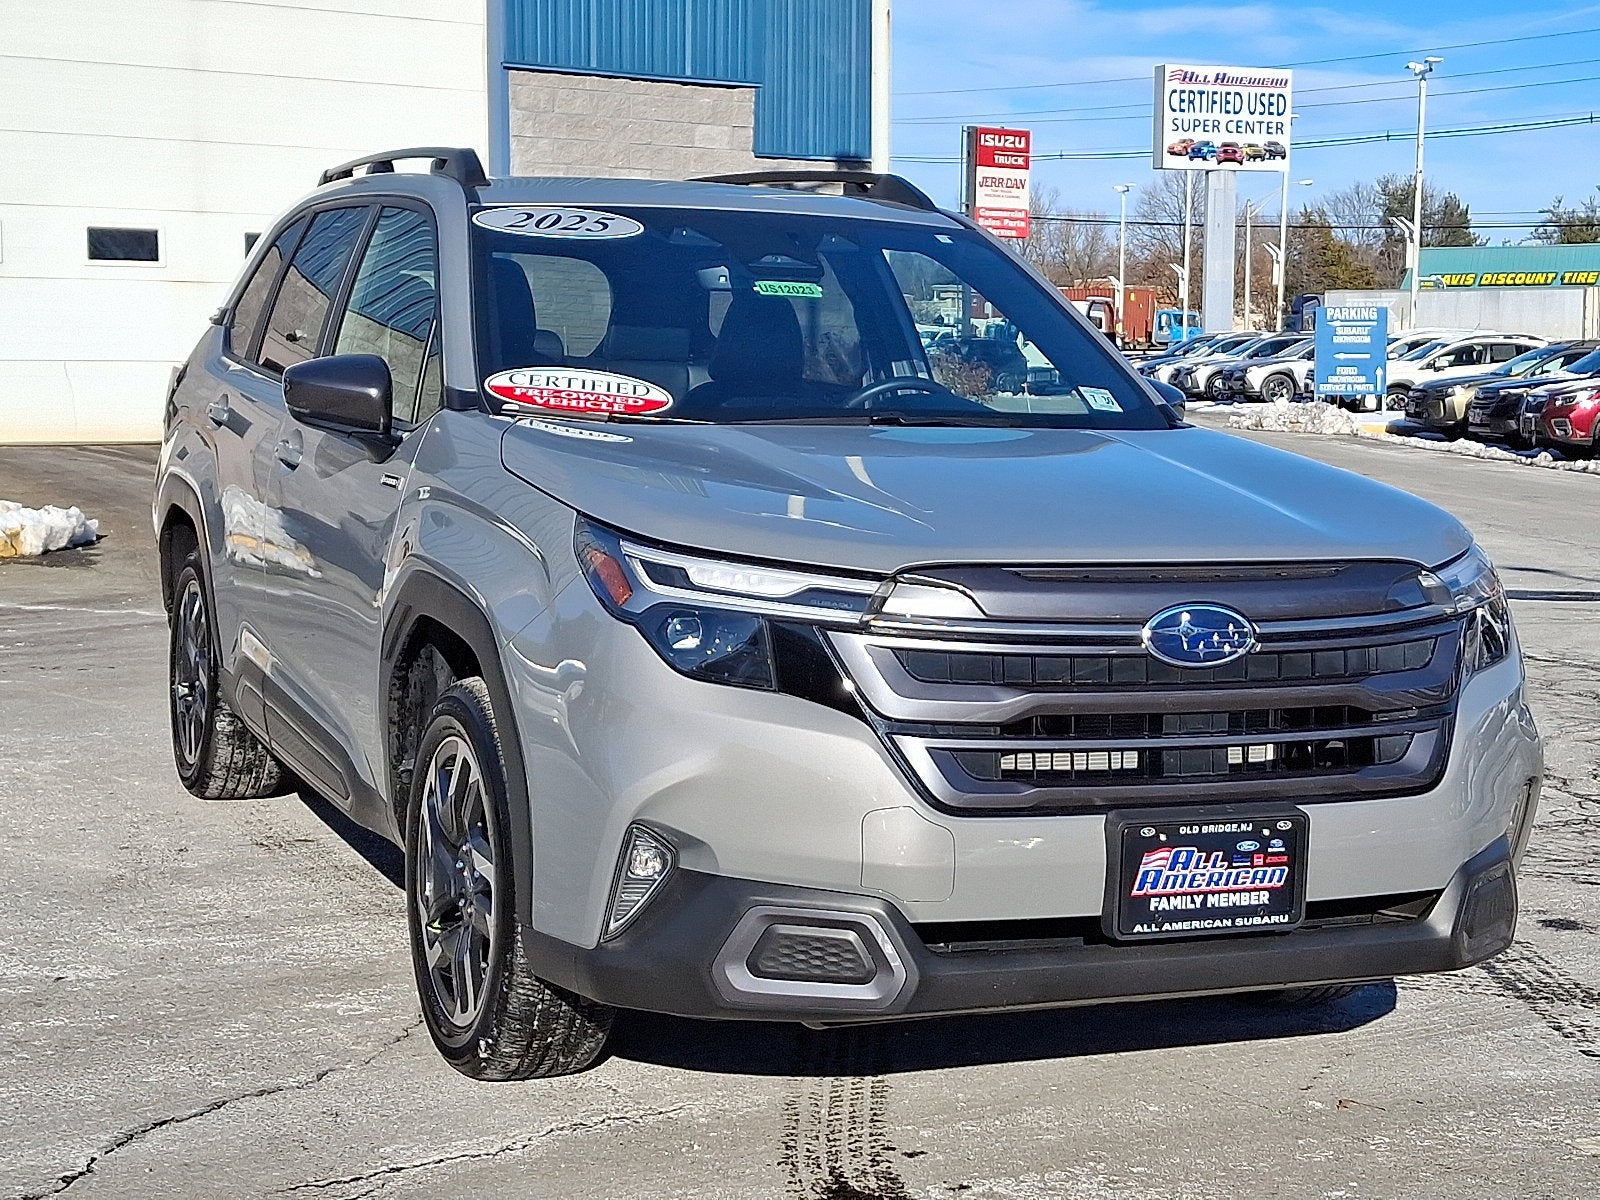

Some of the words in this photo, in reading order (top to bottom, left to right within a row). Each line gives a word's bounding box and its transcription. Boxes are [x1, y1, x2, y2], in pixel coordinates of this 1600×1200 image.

[1169, 89, 1243, 115] CERTIFIED
[1248, 92, 1287, 116] USED
[1172, 118, 1221, 133] SUPER
[1225, 120, 1284, 135] CENTER
[980, 133, 1026, 149] ISUZU
[994, 155, 1025, 166] TRUCK
[507, 212, 616, 233] 2025
[1480, 272, 1557, 286] DISCOUNT
[1562, 271, 1599, 285] TIRE
[758, 283, 815, 295] US12023
[1326, 307, 1378, 320] PARKING
[508, 373, 651, 397] CERTIFIED
[513, 387, 646, 406] PRE-OWNED
[532, 395, 627, 412] VEHICLE
[1179, 825, 1199, 835] OLD
[1150, 895, 1204, 911] FAMILY
[1207, 891, 1270, 908] MEMBER
[1133, 923, 1160, 933] ALL
[1162, 919, 1232, 932] AMERICAN
[1236, 914, 1289, 927] SUBARU
